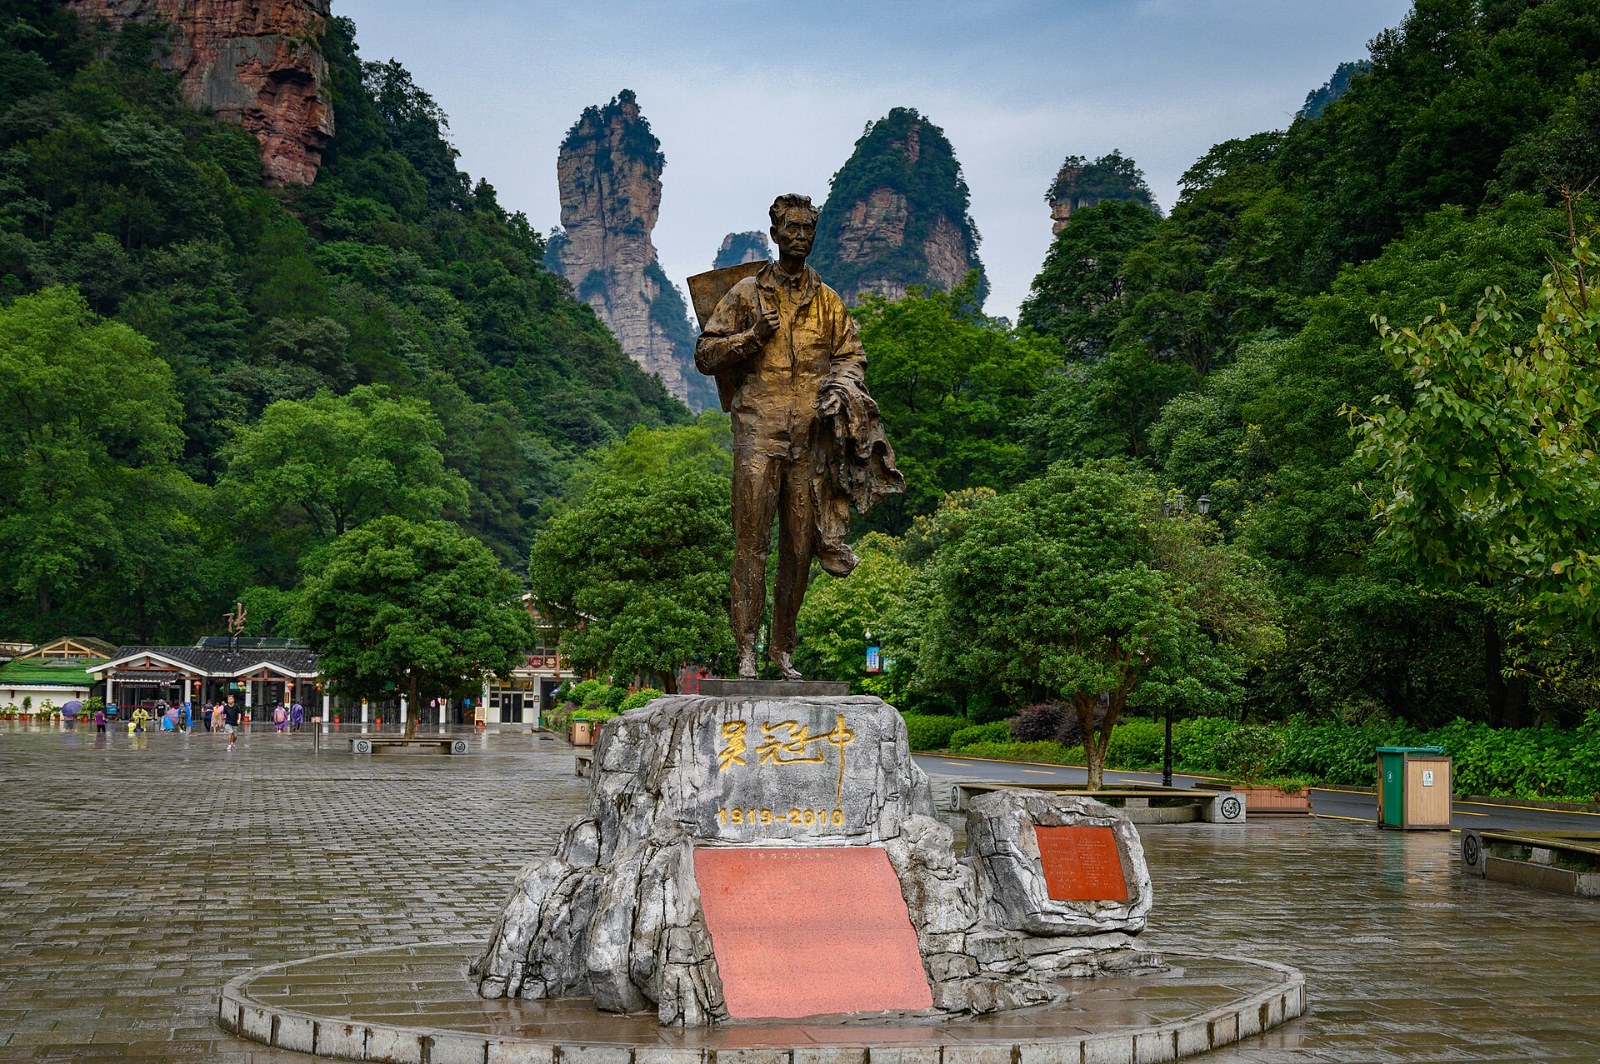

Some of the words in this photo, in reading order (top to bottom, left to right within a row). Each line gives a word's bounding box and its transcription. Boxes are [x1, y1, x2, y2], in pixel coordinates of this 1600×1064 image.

[717, 713, 855, 808] 吴冠中
[719, 808, 845, 827] 1919-2010
